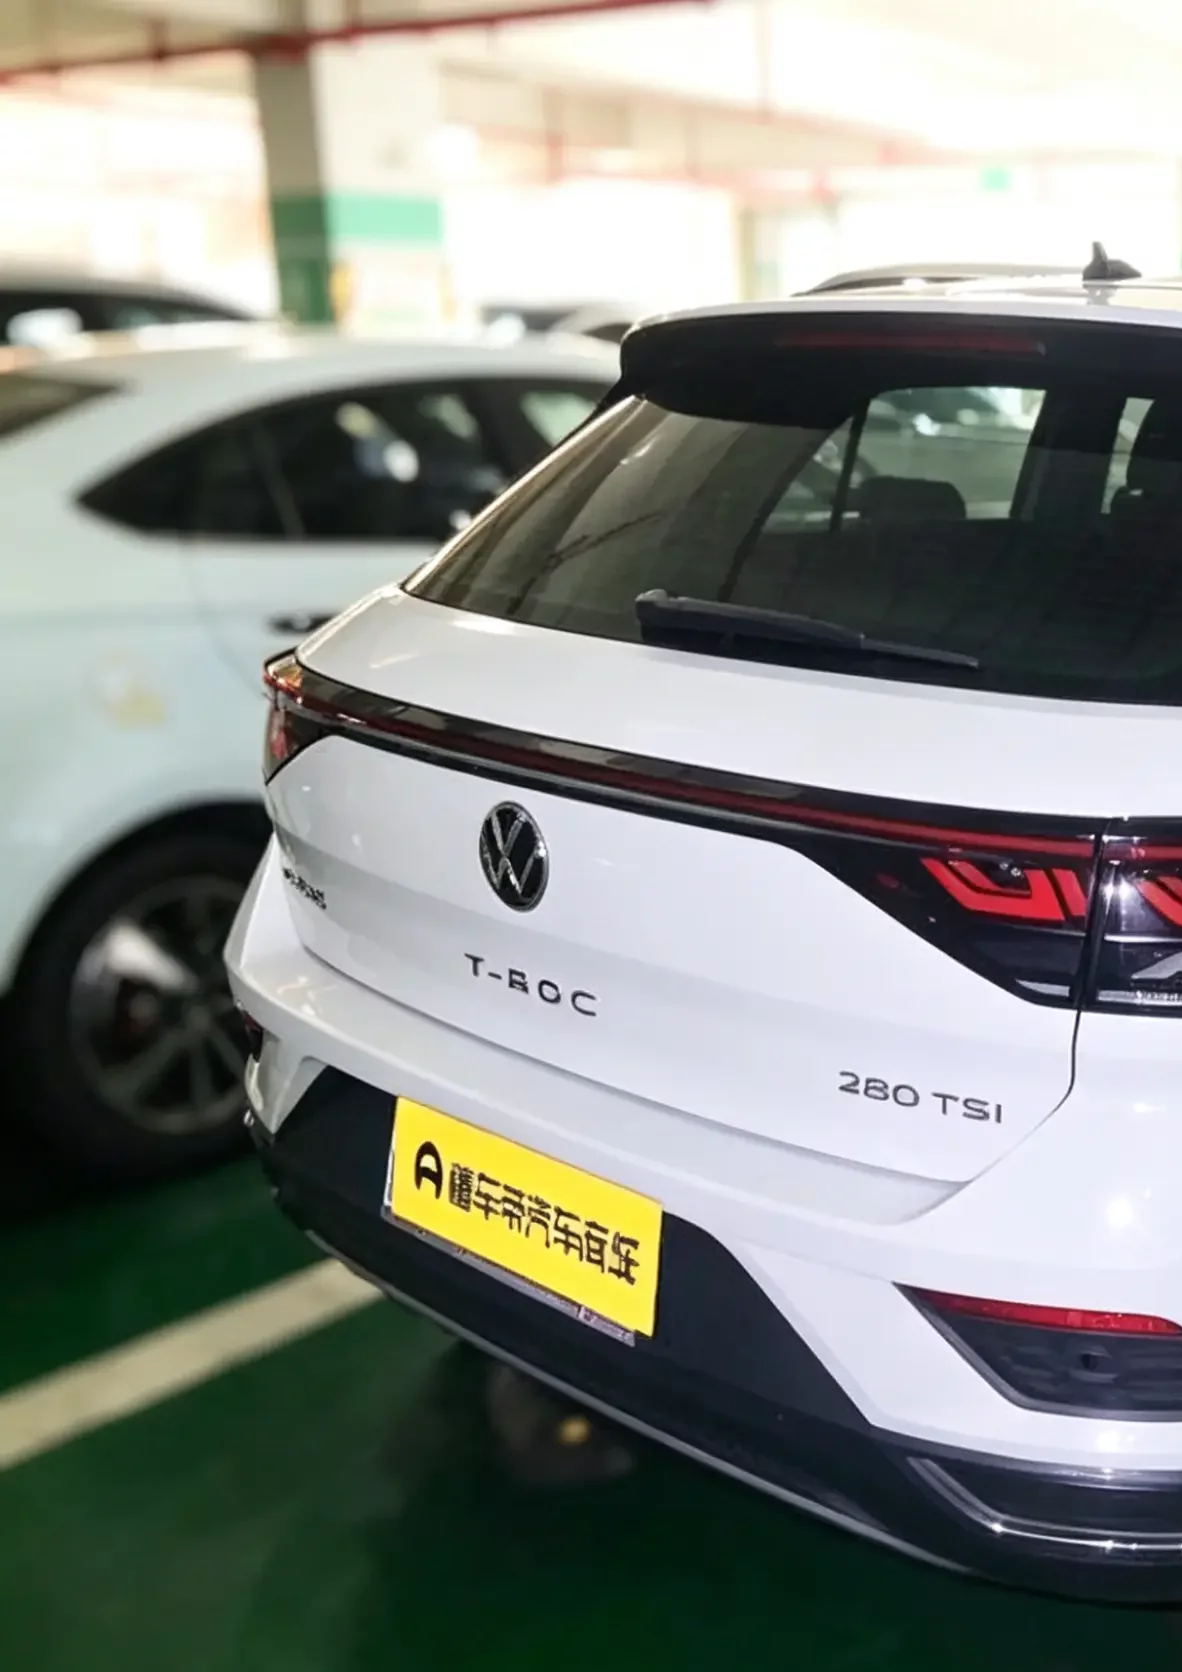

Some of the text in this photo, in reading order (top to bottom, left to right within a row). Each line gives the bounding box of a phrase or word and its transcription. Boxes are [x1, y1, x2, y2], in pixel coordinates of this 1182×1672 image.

[464, 953, 598, 1017] T-ROC
[838, 1071, 1002, 1124] 280 TSI
